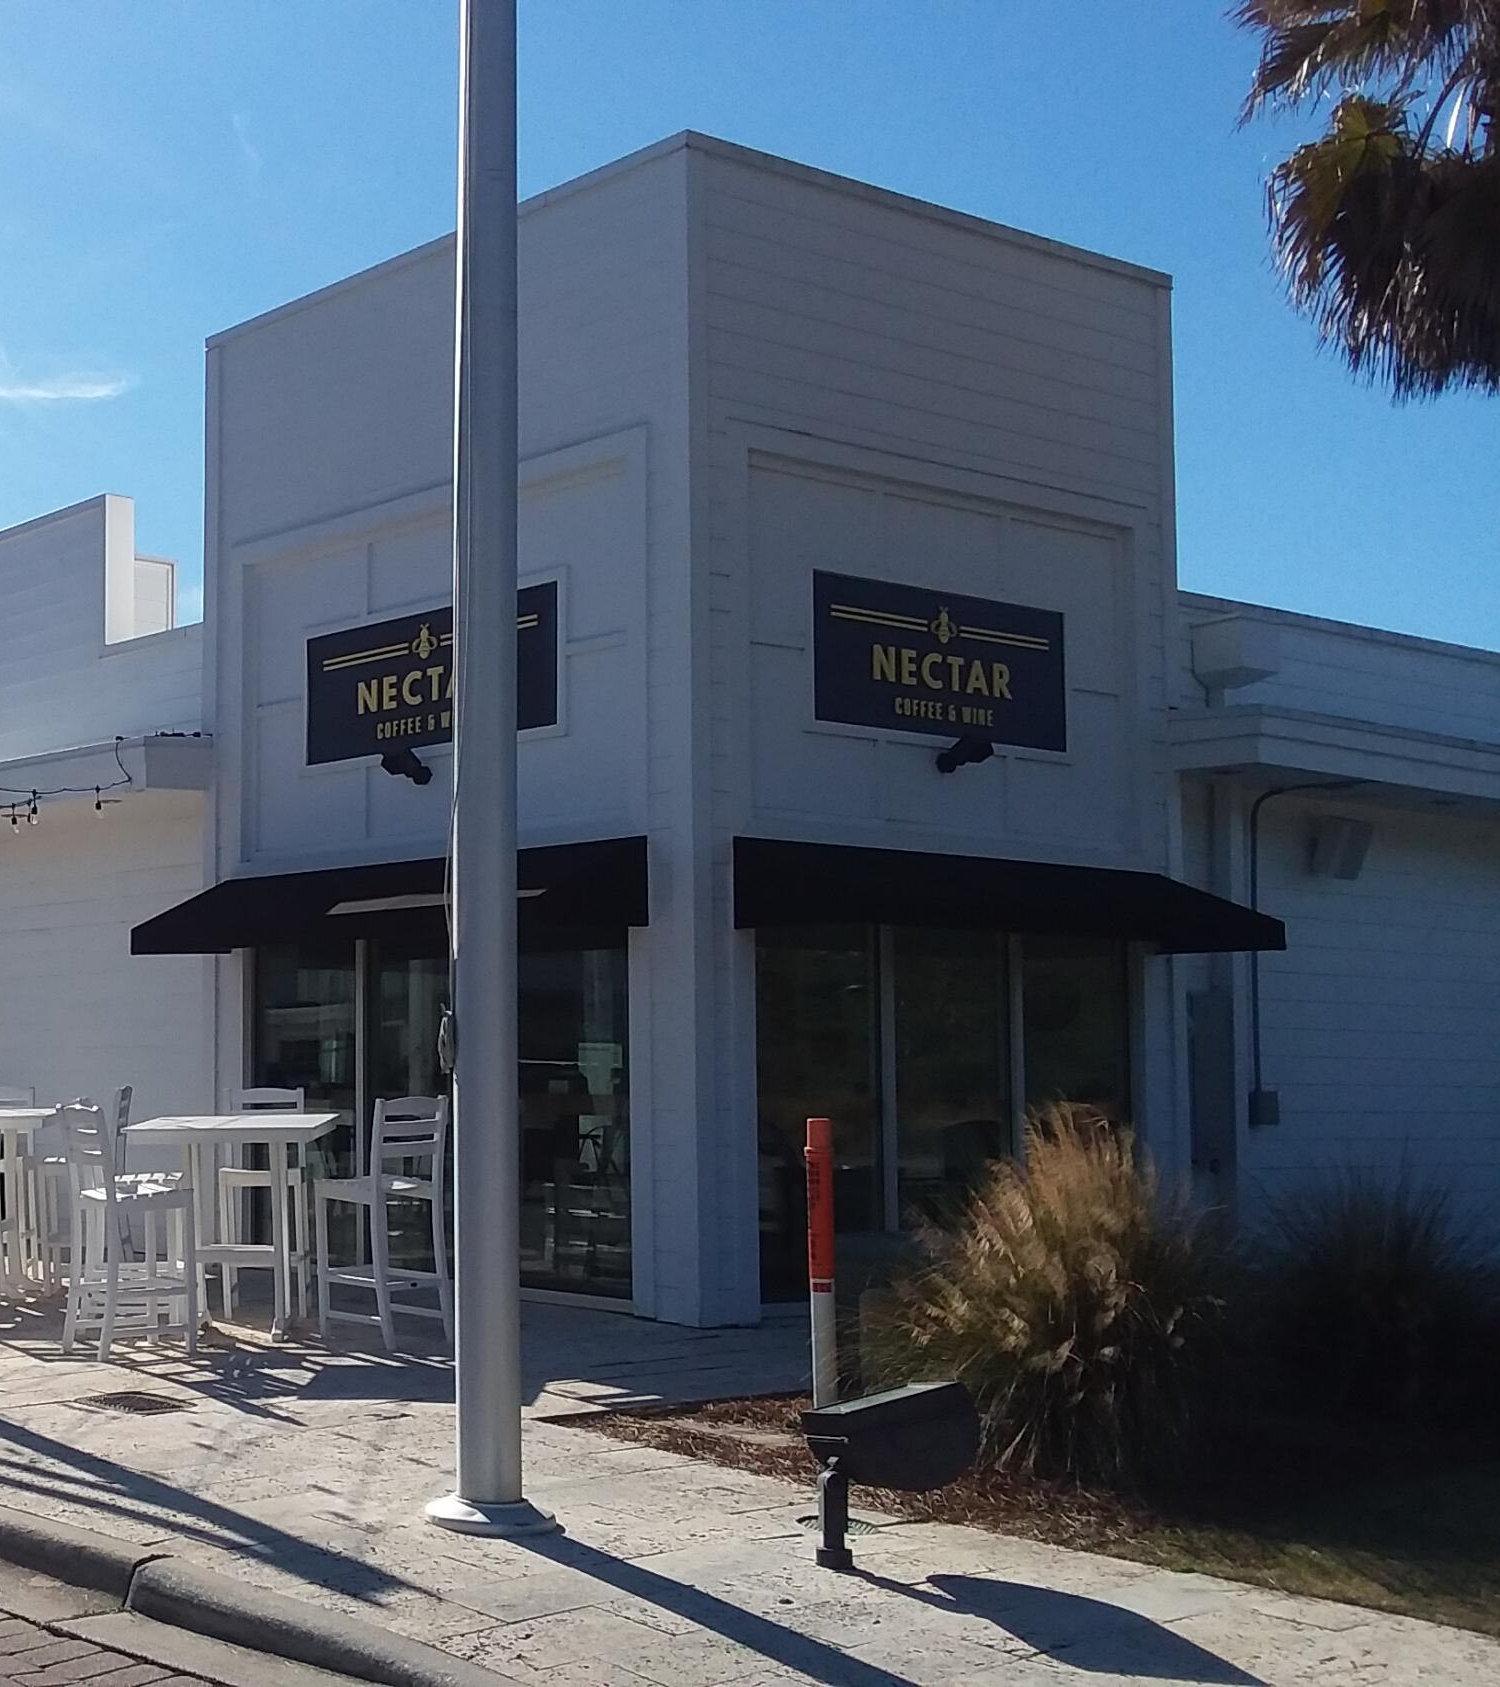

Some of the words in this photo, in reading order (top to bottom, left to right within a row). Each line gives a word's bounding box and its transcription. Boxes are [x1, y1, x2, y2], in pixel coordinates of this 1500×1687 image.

[872, 643, 1012, 700] NECTAR
[377, 716, 422, 739] COFFEE
[427, 714, 436, 731] &
[894, 697, 943, 720] COFFEE
[948, 704, 956, 722] &
[961, 706, 994, 727] WINE
